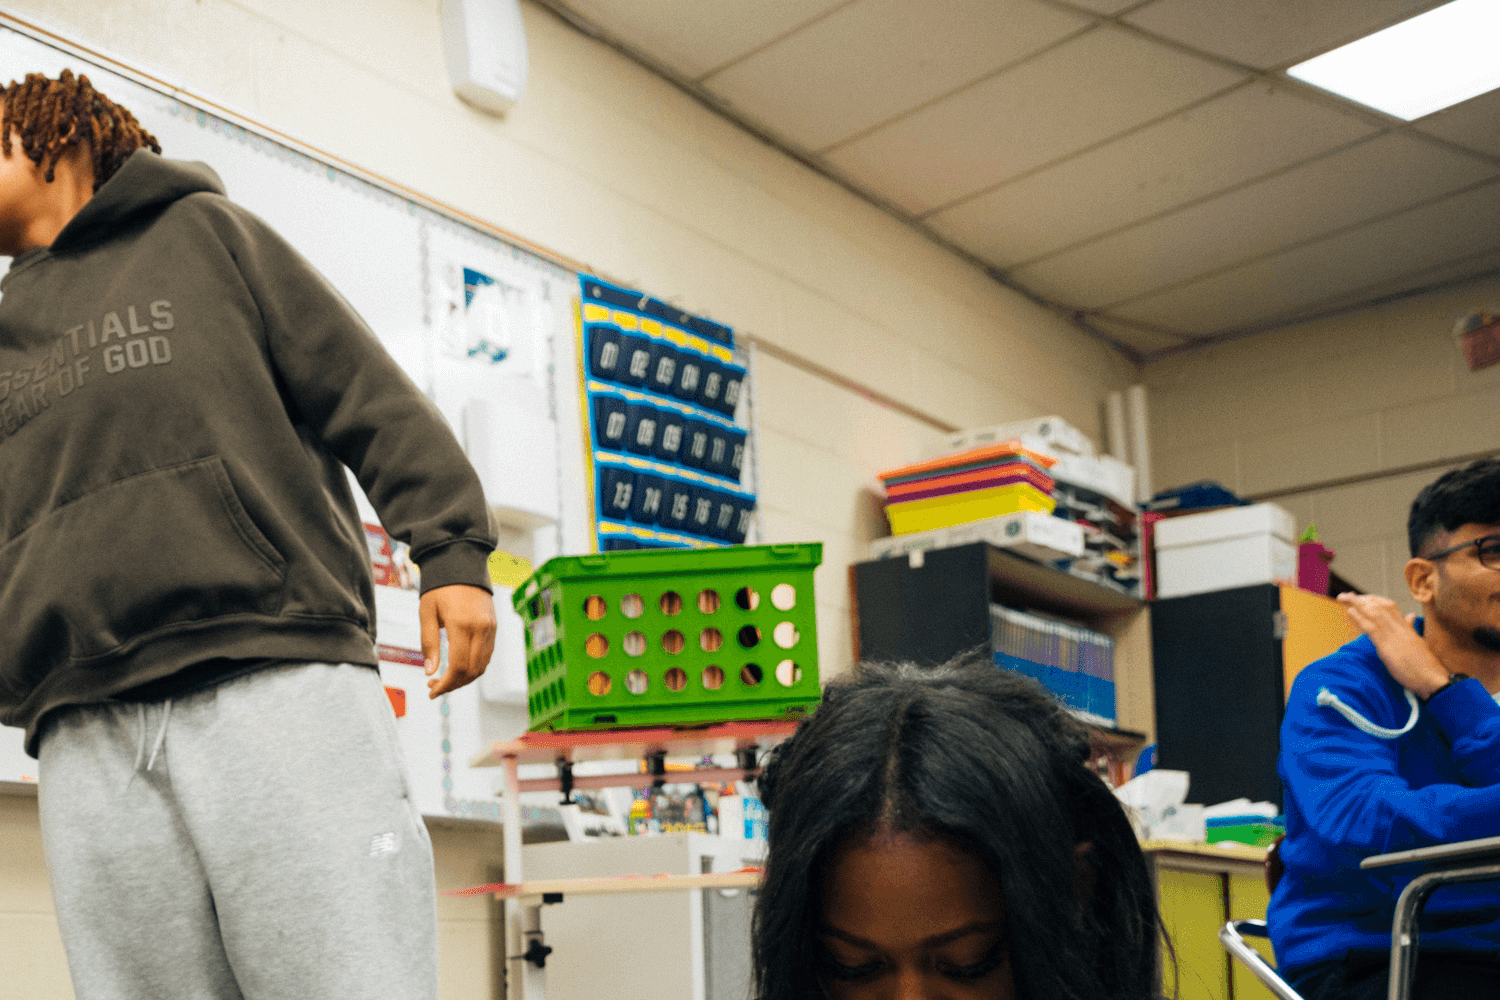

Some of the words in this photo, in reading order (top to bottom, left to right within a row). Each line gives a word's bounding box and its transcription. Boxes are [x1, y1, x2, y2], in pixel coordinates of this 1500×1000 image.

[54, 354, 91, 398] OF
[103, 335, 173, 376] GOD
[600, 341, 619, 370] 01
[629, 349, 650, 379] 02
[612, 481, 633, 510] 13
[642, 486, 662, 515] 14
[671, 492, 689, 521] 15
